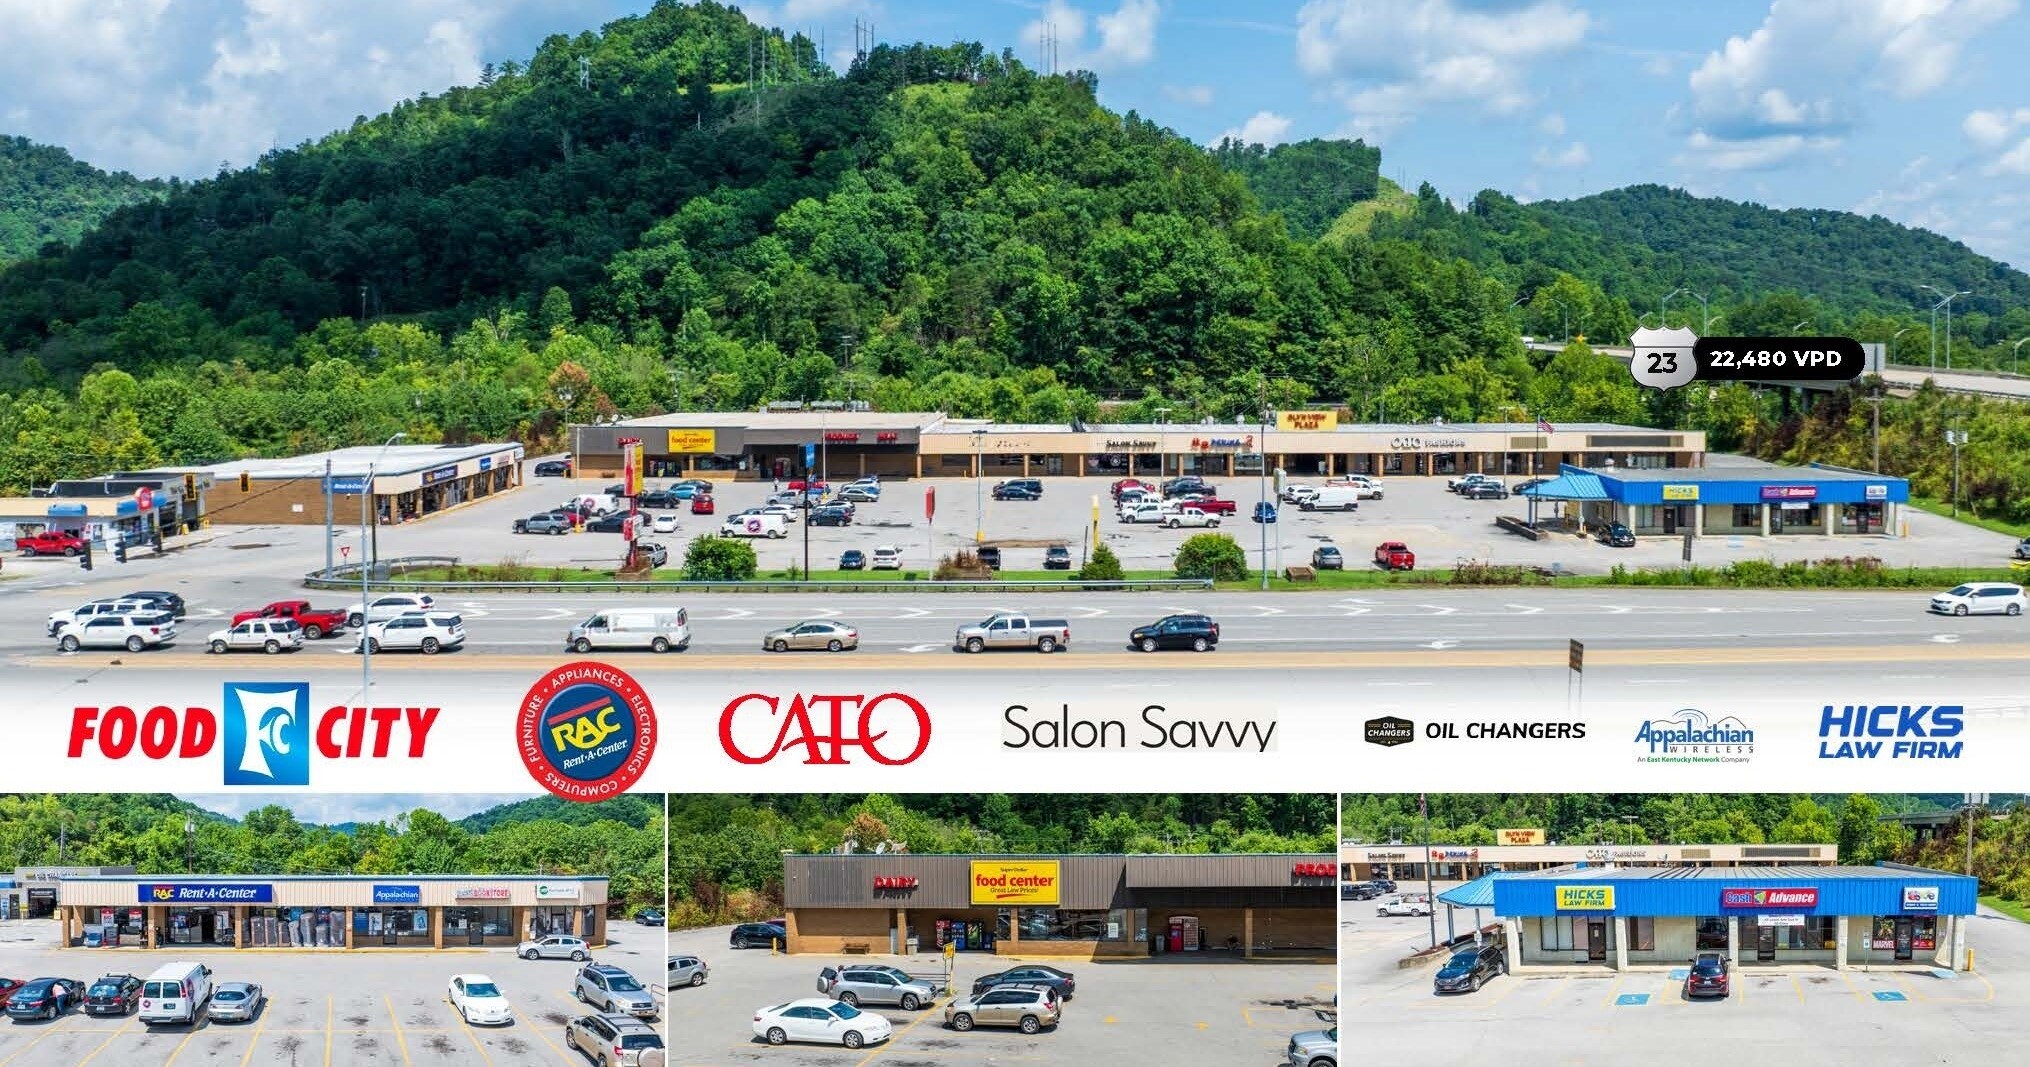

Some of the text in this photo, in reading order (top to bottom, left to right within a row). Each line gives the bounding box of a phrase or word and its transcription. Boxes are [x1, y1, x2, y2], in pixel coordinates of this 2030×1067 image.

[976, 873, 1055, 887] food center
[153, 888, 175, 900] RAC
[375, 890, 419, 900] Appalachian
[1564, 889, 1605, 899] HICKS
[1726, 891, 1815, 904] Cash Advance
[1872, 940, 1896, 949] MARVEL
